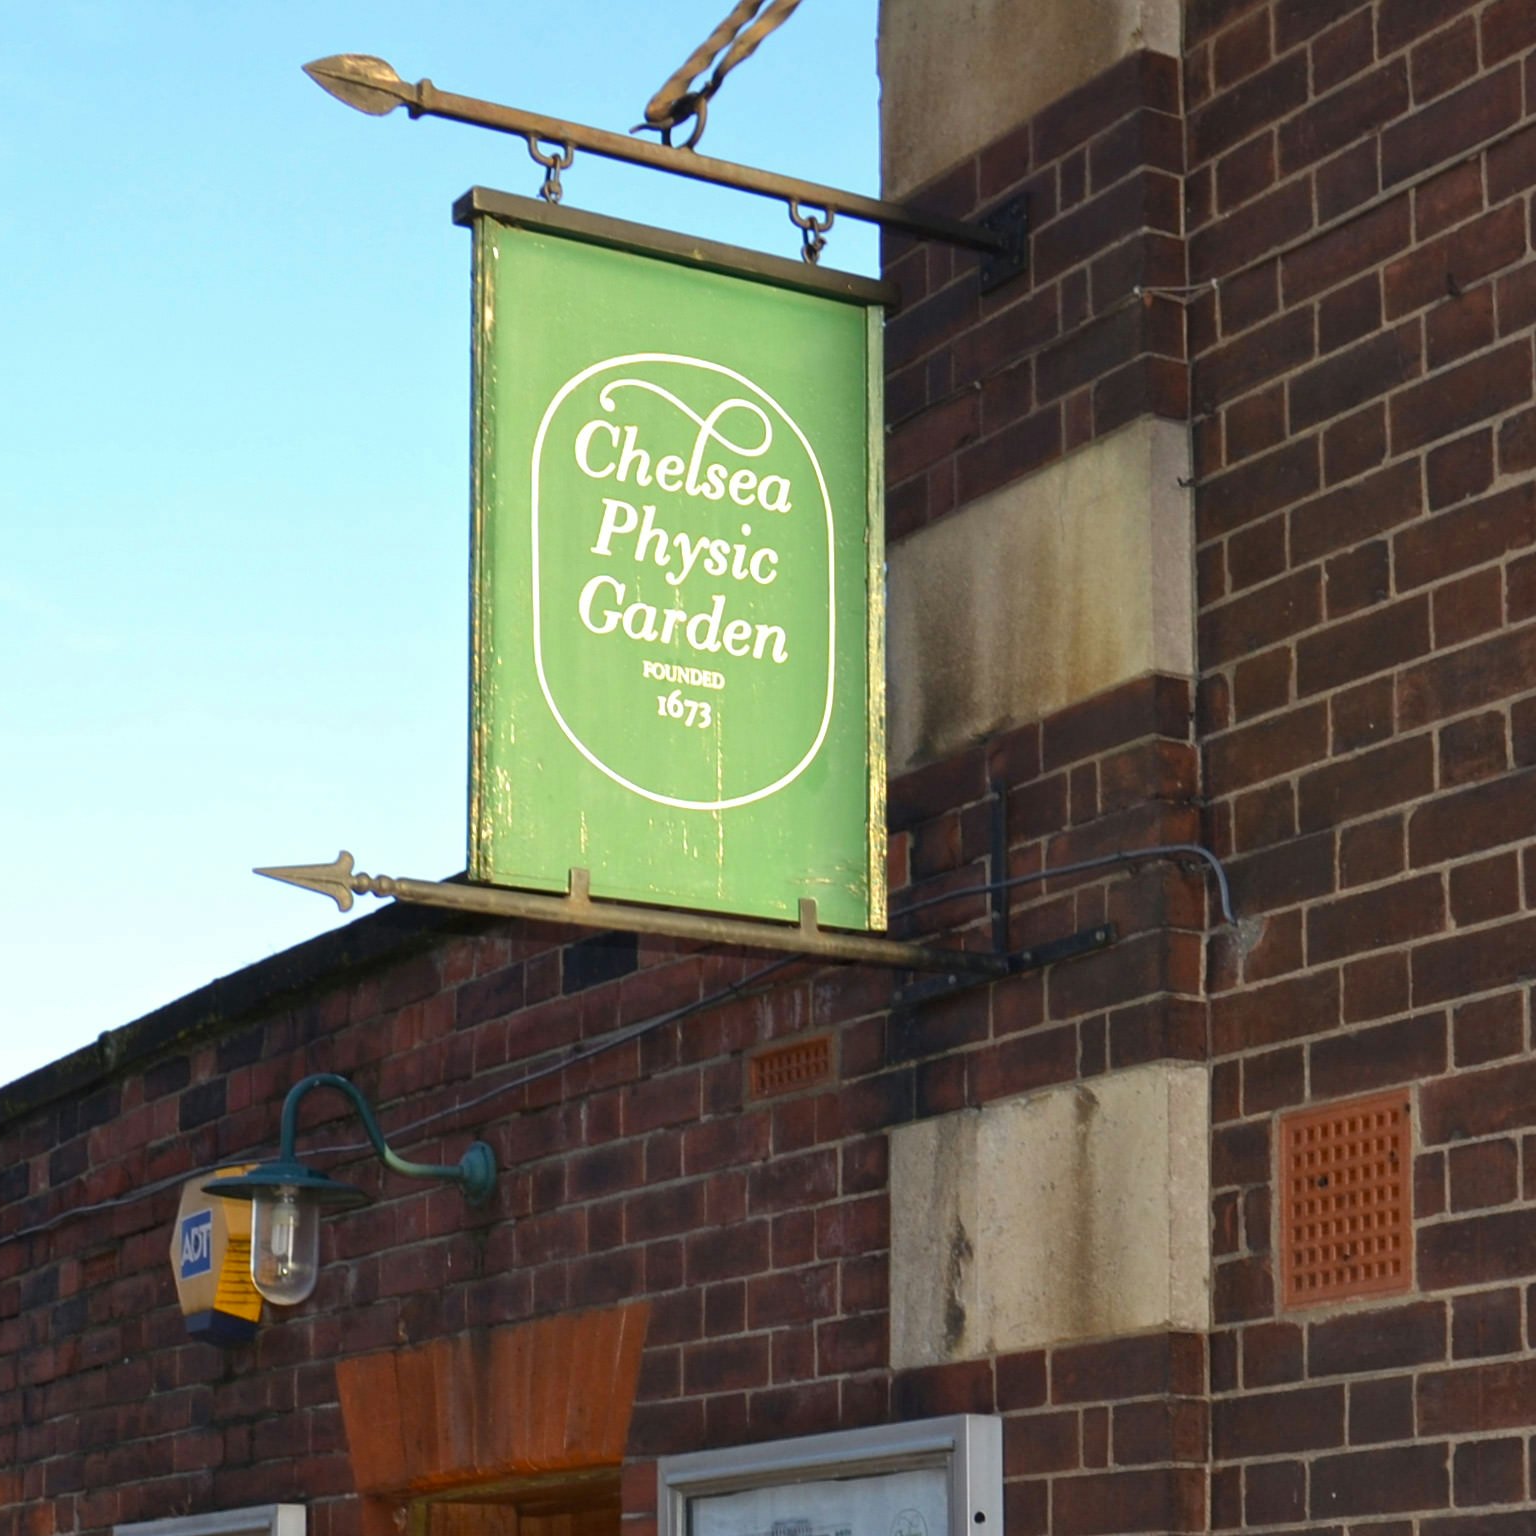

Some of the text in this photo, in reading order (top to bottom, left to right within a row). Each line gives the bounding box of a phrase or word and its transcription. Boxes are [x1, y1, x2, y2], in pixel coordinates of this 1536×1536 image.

[574, 394, 793, 515] Chelsea
[591, 496, 780, 586] Physic
[577, 572, 790, 665] Garden
[642, 659, 726, 691] FOUNDED
[656, 691, 712, 730] 1673
[181, 1222, 213, 1265] ADT
